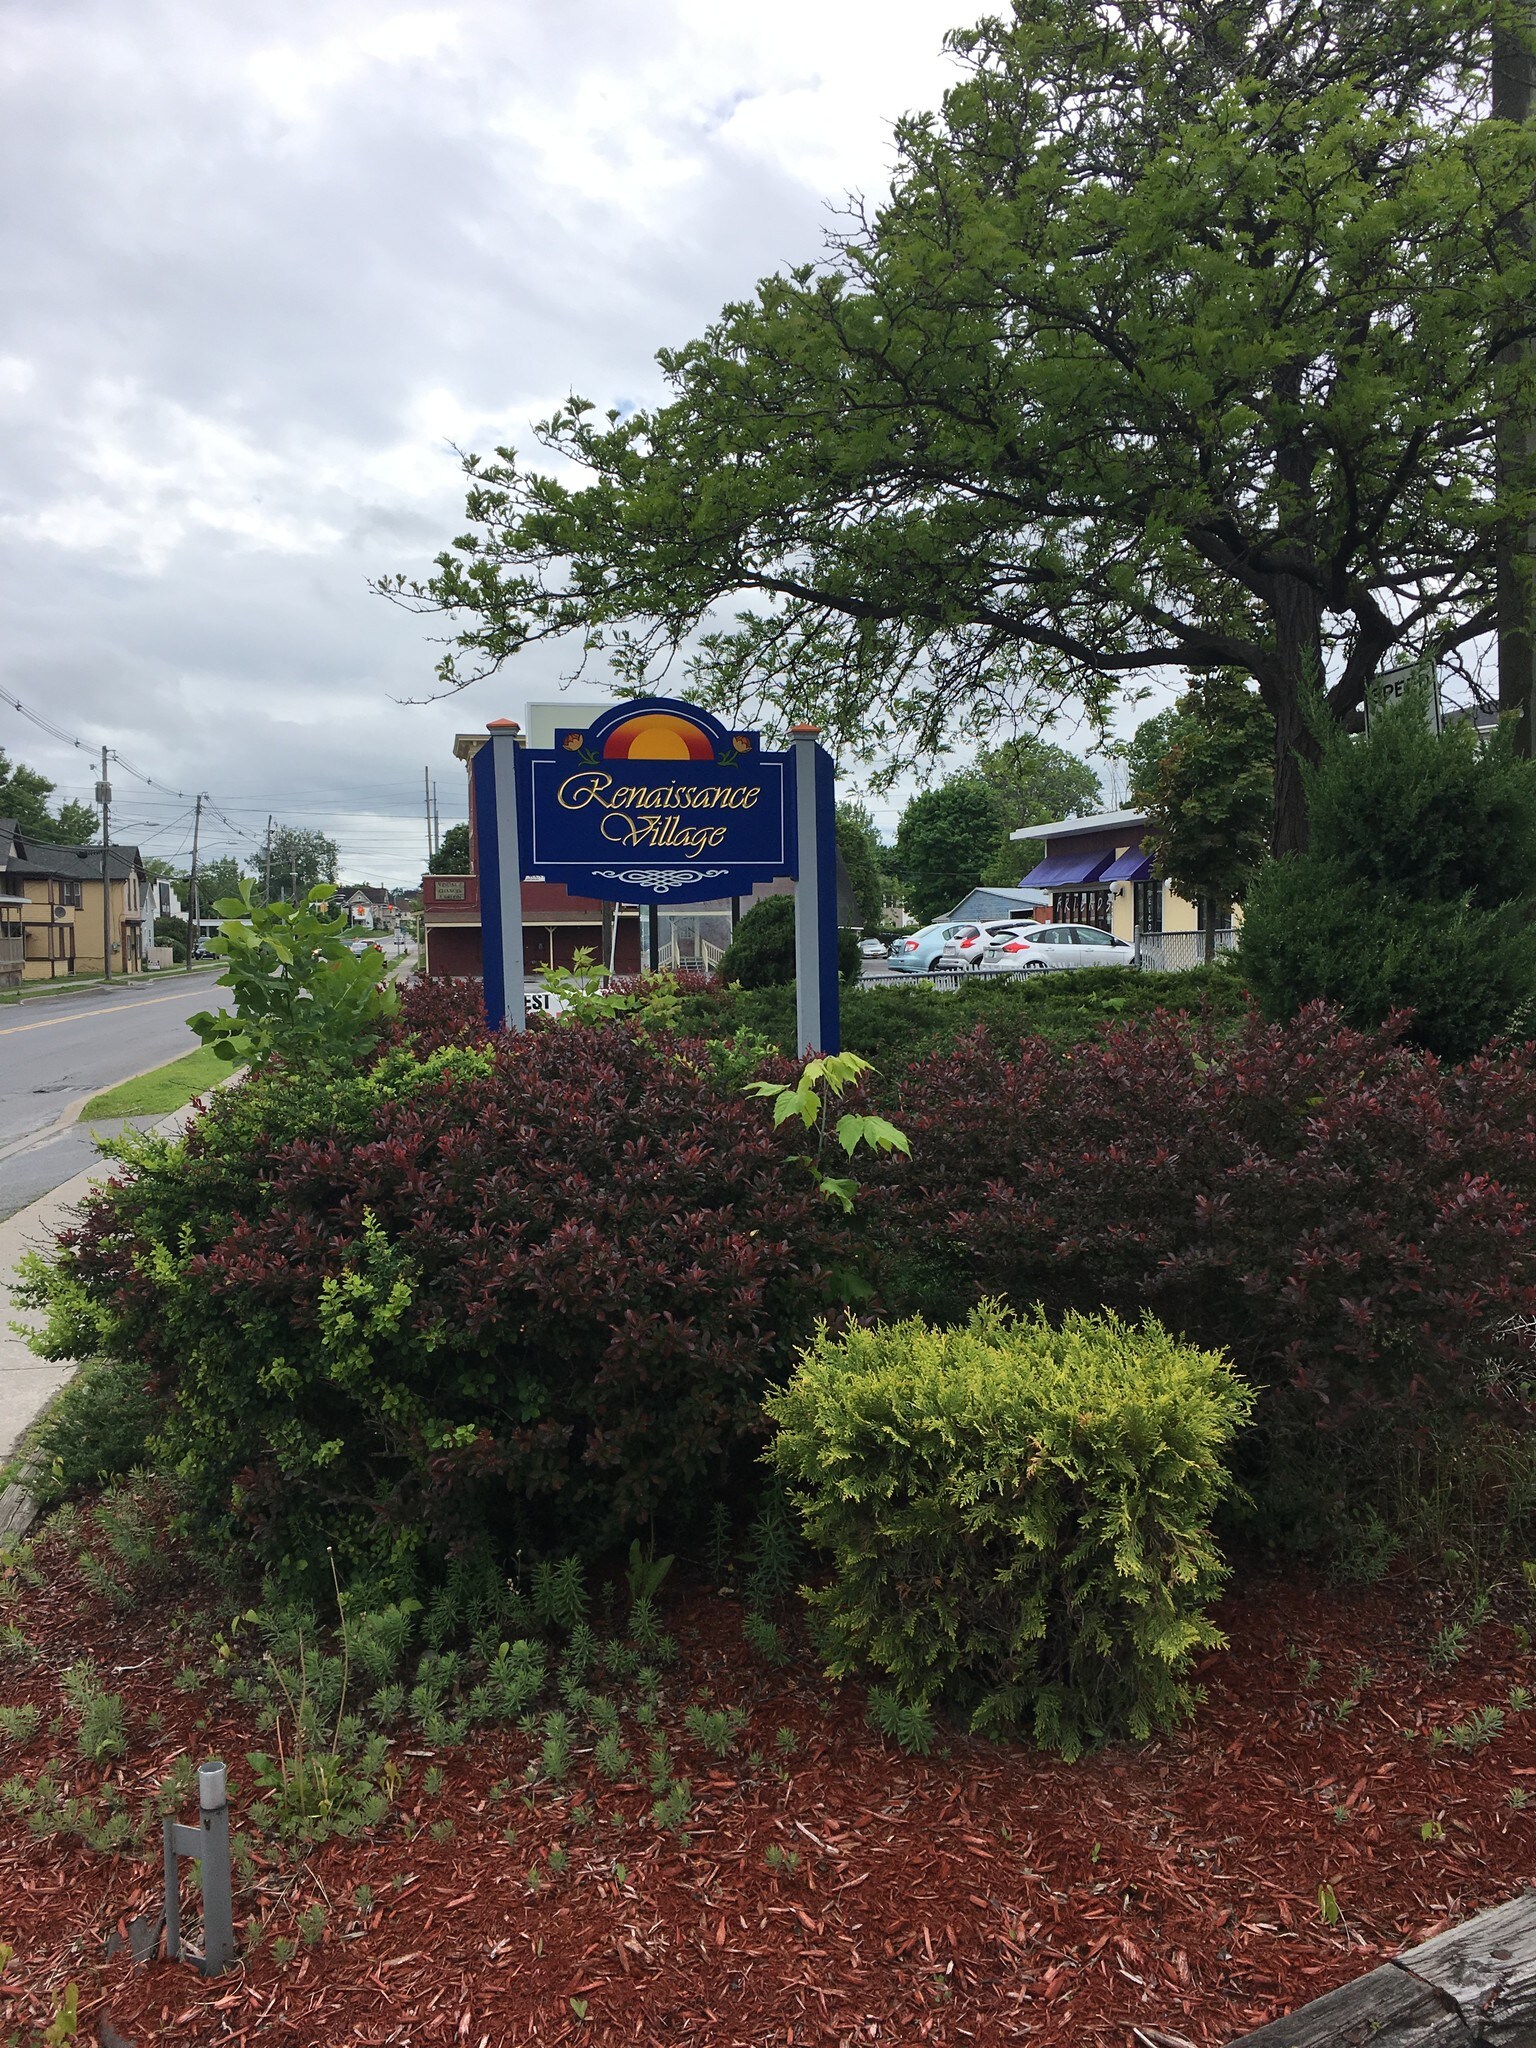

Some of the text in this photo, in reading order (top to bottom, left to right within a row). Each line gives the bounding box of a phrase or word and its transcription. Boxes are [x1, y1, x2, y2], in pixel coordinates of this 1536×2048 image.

[1371, 673, 1430, 702] SPED
[557, 771, 761, 809] Renaissance
[600, 812, 728, 859] Village
